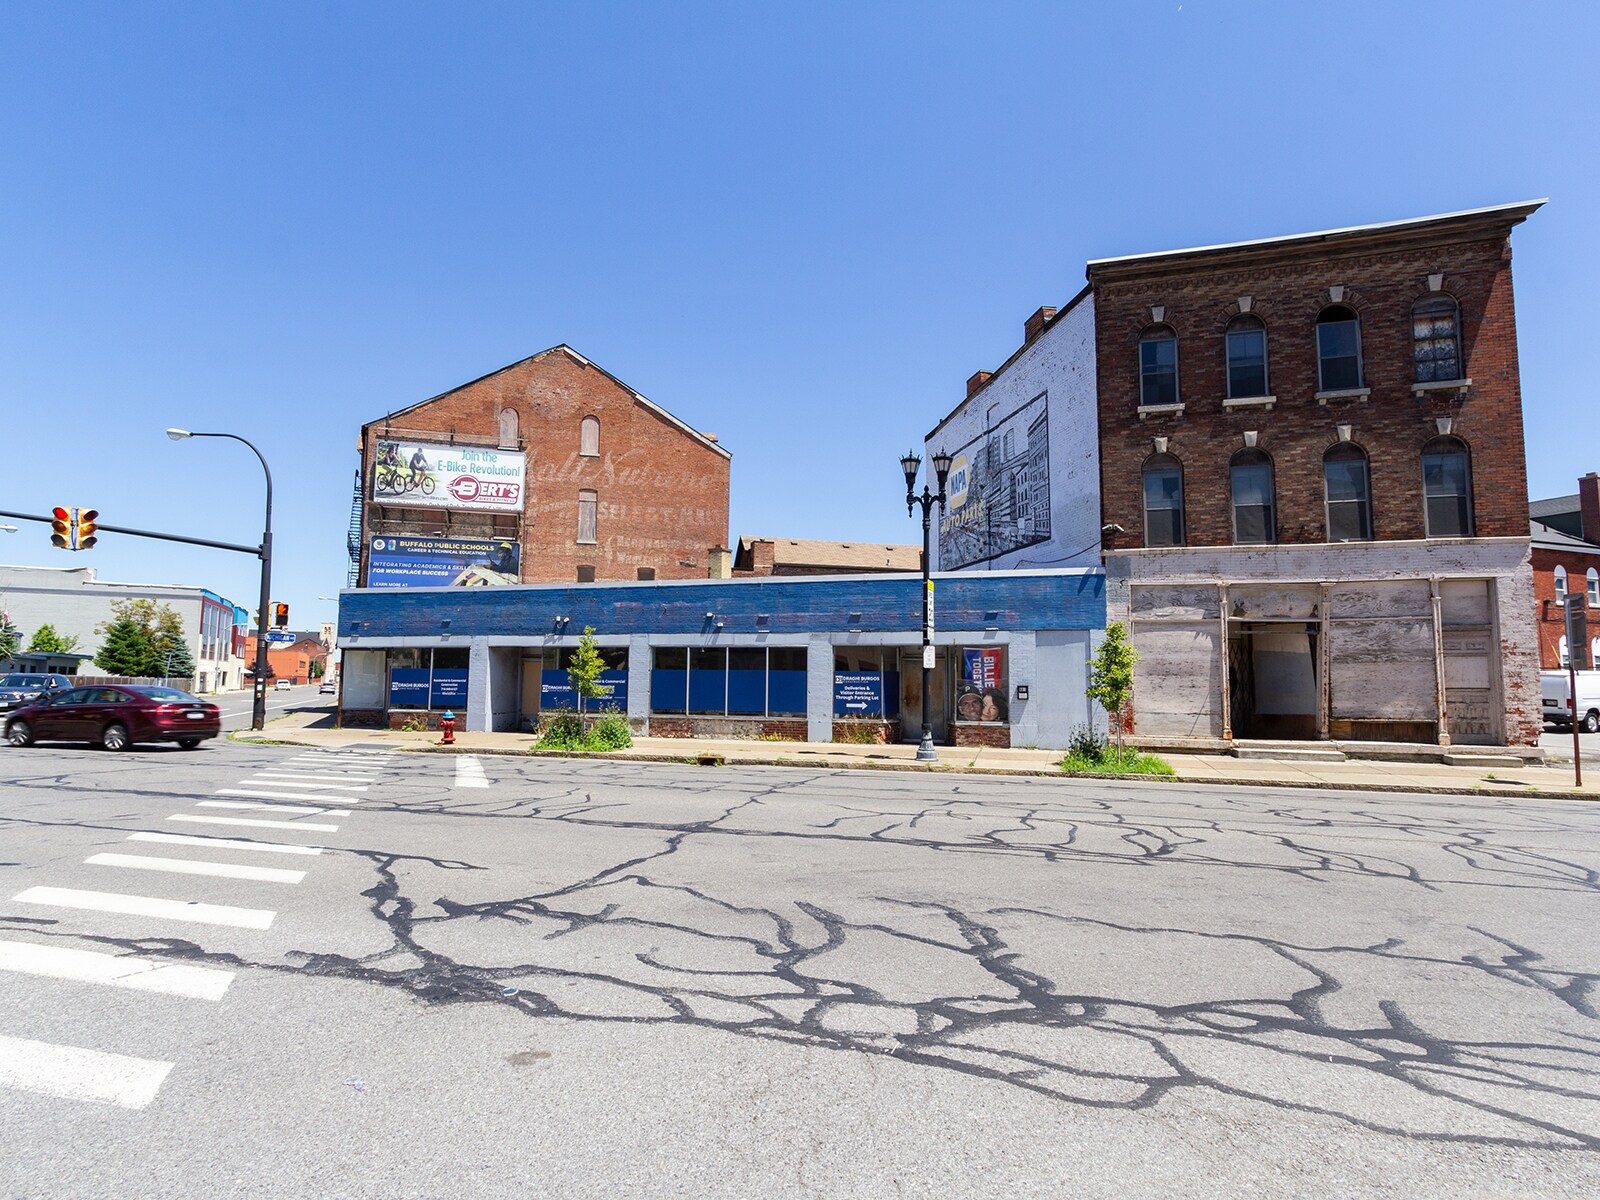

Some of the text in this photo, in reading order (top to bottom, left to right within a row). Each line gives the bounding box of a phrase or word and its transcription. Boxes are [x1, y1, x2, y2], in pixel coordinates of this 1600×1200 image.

[461, 449, 498, 463] Join the
[437, 460, 520, 476] E-Bike Revolution!
[457, 480, 520, 498] BERT'S
[950, 469, 967, 496] NAPA
[942, 501, 984, 532] AUTO PARTS
[434, 542, 460, 550] PUBLIC
[983, 656, 995, 688] BILLIE
